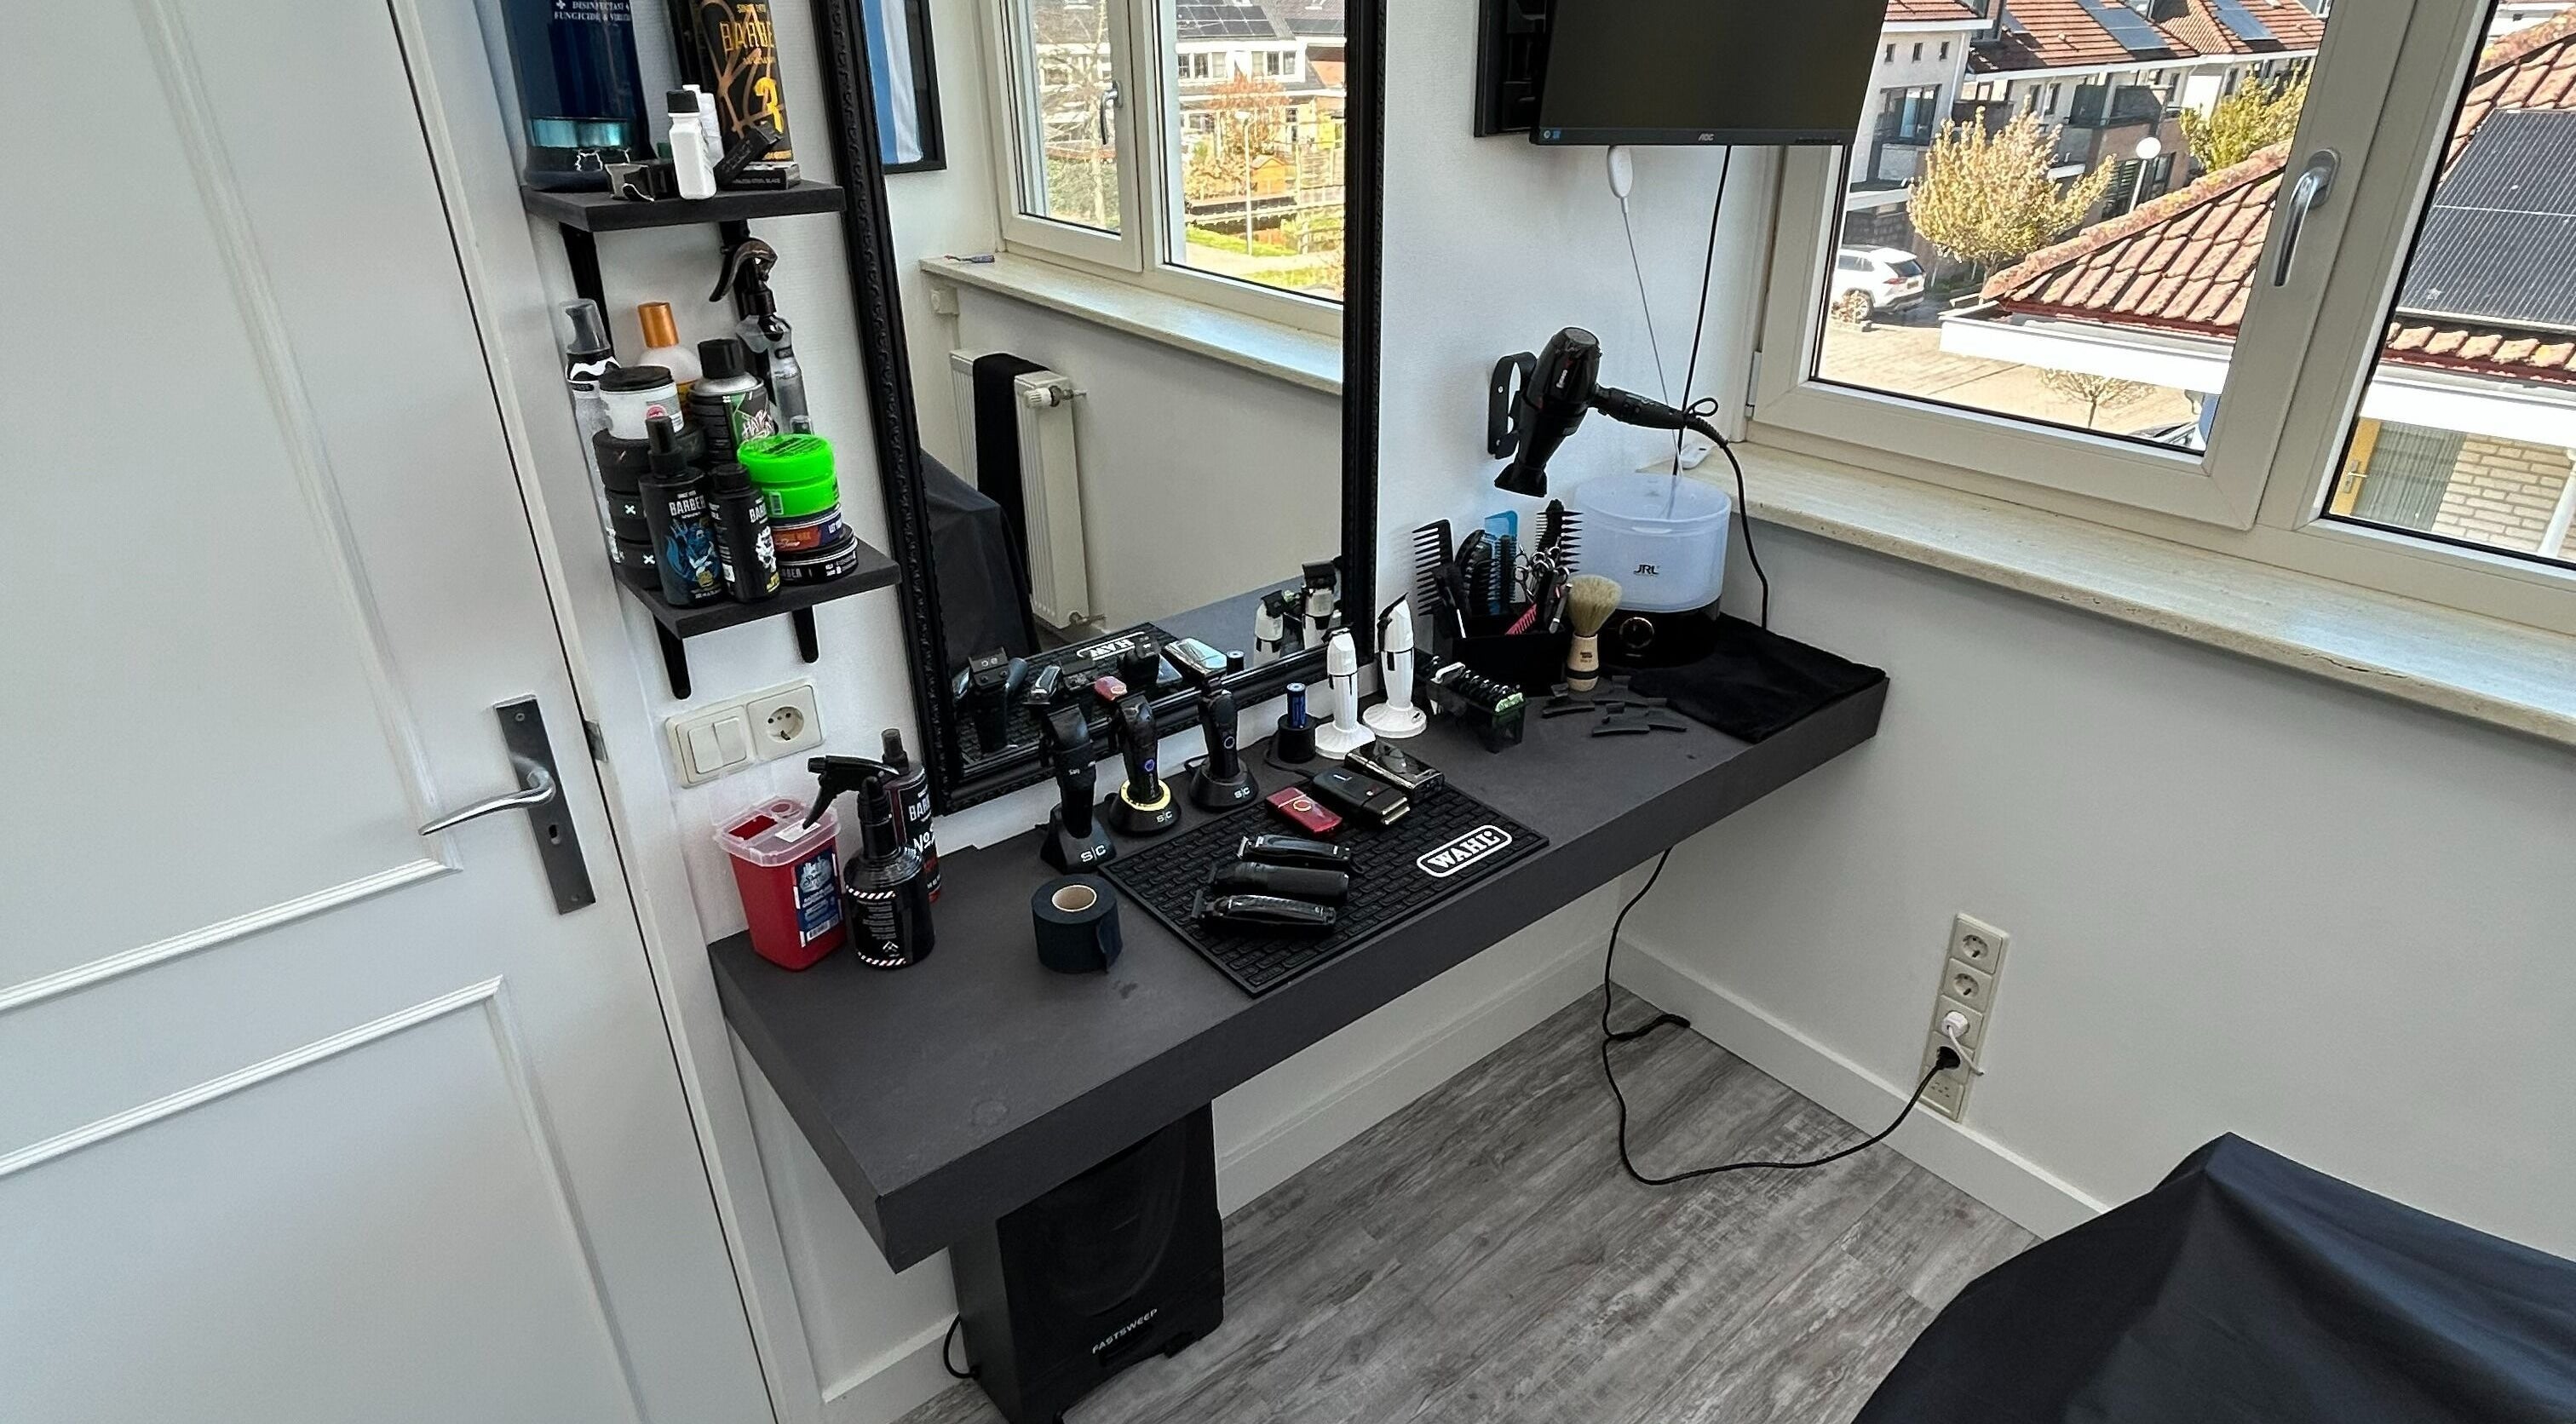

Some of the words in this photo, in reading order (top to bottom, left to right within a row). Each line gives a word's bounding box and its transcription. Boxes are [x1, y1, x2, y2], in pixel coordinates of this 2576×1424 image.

[669, 495, 706, 516] BARBER
[1427, 831, 1501, 868] WAHL
[1092, 1308, 1158, 1354] FASTSWEEP
